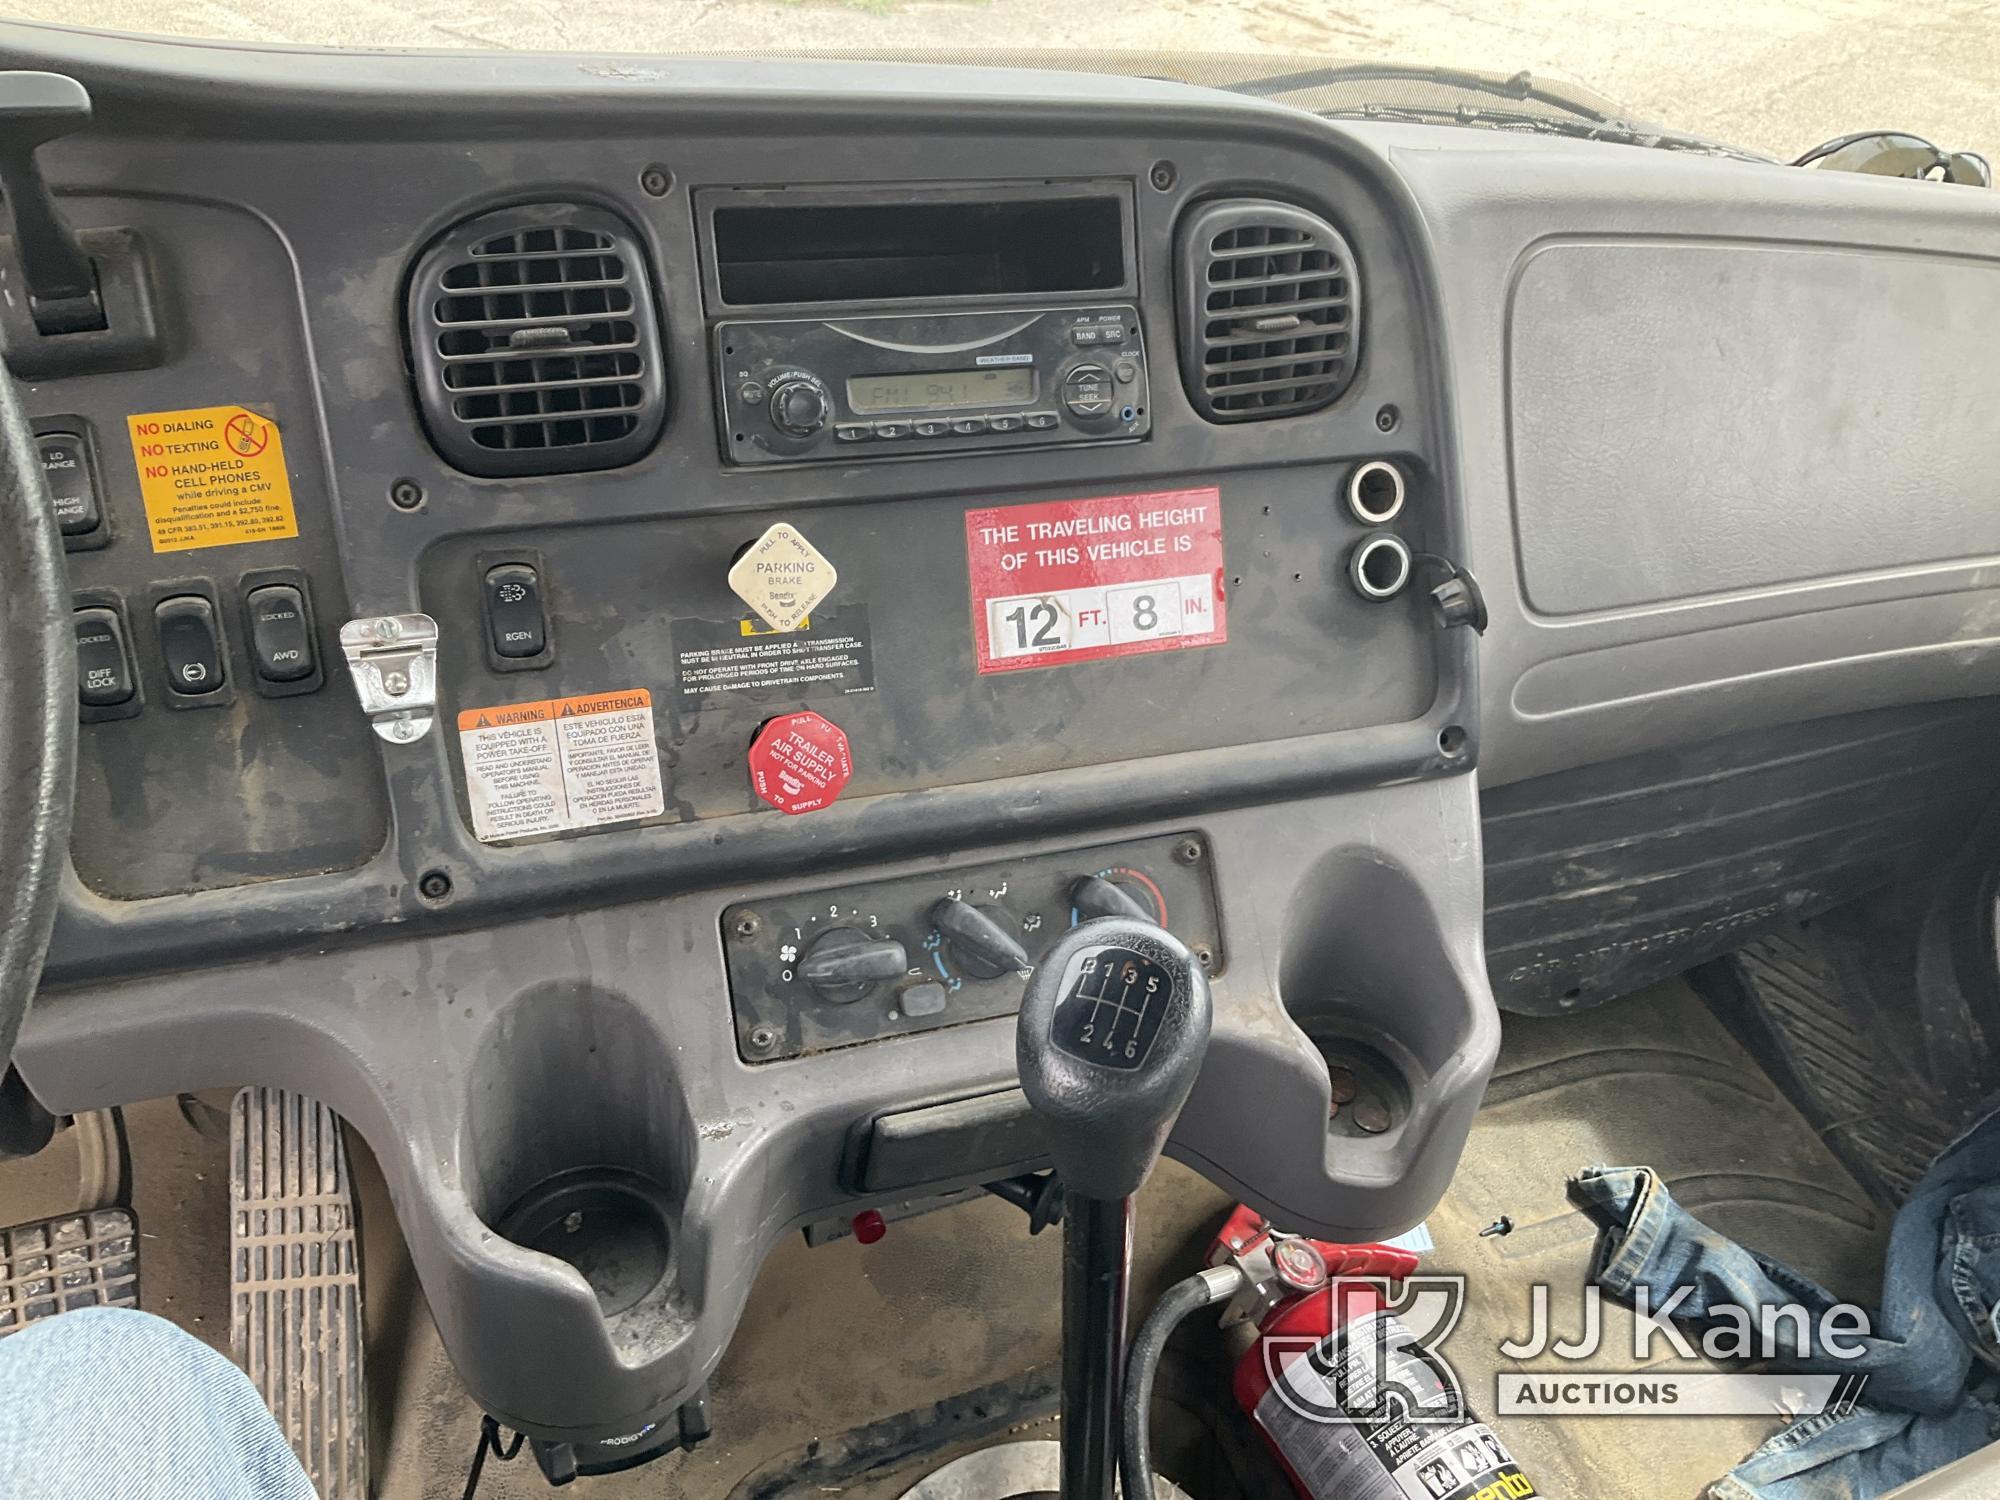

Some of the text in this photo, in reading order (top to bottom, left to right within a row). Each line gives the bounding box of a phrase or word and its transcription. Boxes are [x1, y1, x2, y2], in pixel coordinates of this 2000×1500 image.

[1076, 332, 1096, 340] BAND
[1105, 330, 1121, 339] SRC
[136, 420, 214, 436] NO DIALING
[965, 422, 971, 431] 4
[1002, 420, 1009, 429] 5
[1039, 417, 1045, 426] 6
[850, 429, 856, 439] 1
[889, 427, 896, 436] 2
[927, 425, 934, 434] 3
[140, 440, 219, 457] NO TEXTING
[145, 459, 244, 479] NO HAND-HELD
[174, 471, 261, 489] CELL PHONES
[176, 490, 203, 501] while
[205, 485, 239, 498] driving
[249, 483, 272, 492] CMV
[172, 498, 261, 513] Penalties could include
[155, 511, 214, 525] disqualification
[216, 509, 230, 517] and
[979, 506, 1208, 546] THE TRAVELING HEIGHT
[759, 531, 811, 558] PULL TO APPLY
[1000, 535, 1193, 571] OF THIS VEHICLE IS
[756, 562, 815, 574] PARKING
[768, 576, 803, 586] BRAKE
[260, 611, 295, 622] LOCKED
[780, 619, 791, 627] TO
[791, 593, 817, 621] RELEASE
[1005, 595, 1207, 649] 12 FT. 8 IN.
[505, 631, 532, 642] RGEN
[806, 636, 854, 646] TRANSMISSION
[273, 650, 298, 662] AWD
[680, 650, 710, 659] PARKING
[734, 646, 753, 654] MUST
[764, 642, 792, 650] APPLIED
[758, 649, 782, 657] ORDER
[708, 665, 739, 674] OPERATE
[739, 663, 756, 671] WITH
[757, 661, 779, 669] FRONT
[817, 654, 849, 663] ENGAGED
[88, 668, 111, 680] DIFF
[682, 675, 697, 683] FOR
[698, 671, 739, 681] PROLONGED
[740, 668, 769, 677] PERIODS
[806, 662, 825, 670] HARD
[87, 677, 117, 689] LOCK
[683, 687, 698, 695] MAY
[699, 684, 722, 693] CAUSE
[722, 682, 751, 690] DAMAGE
[761, 677, 799, 686] DRIVETRAIN
[576, 696, 644, 714] ADVERTENCIA
[495, 709, 545, 724] WARNING
[563, 713, 646, 731] ESTE VEHICULO ESTA
[478, 733, 497, 742] THIS
[497, 728, 532, 740] VEHICLE
[566, 722, 645, 739] EQUIPADO CON UNA
[475, 739, 517, 752] EQUIPPED
[518, 737, 539, 746] WITH
[572, 737, 596, 746] TOMA
[610, 732, 642, 743] FUERZA
[476, 744, 547, 760] POWER TAKE-OFF
[788, 731, 835, 767] TRAILER
[770, 738, 837, 782] AIR SUPPLY
[768, 749, 826, 789] NOT FOR PARKING
[757, 770, 823, 811] PUSH TO SUPPLY
[830, 906, 838, 918] 2
[869, 915, 878, 927] 3
[795, 927, 801, 940] 1
[1080, 959, 1097, 974] R
[1104, 962, 1114, 978] 1
[1125, 969, 1138, 984] 3
[1145, 975, 1159, 993] 5
[1080, 1023, 1094, 1043] 2
[1125, 1040, 1138, 1059] 6
